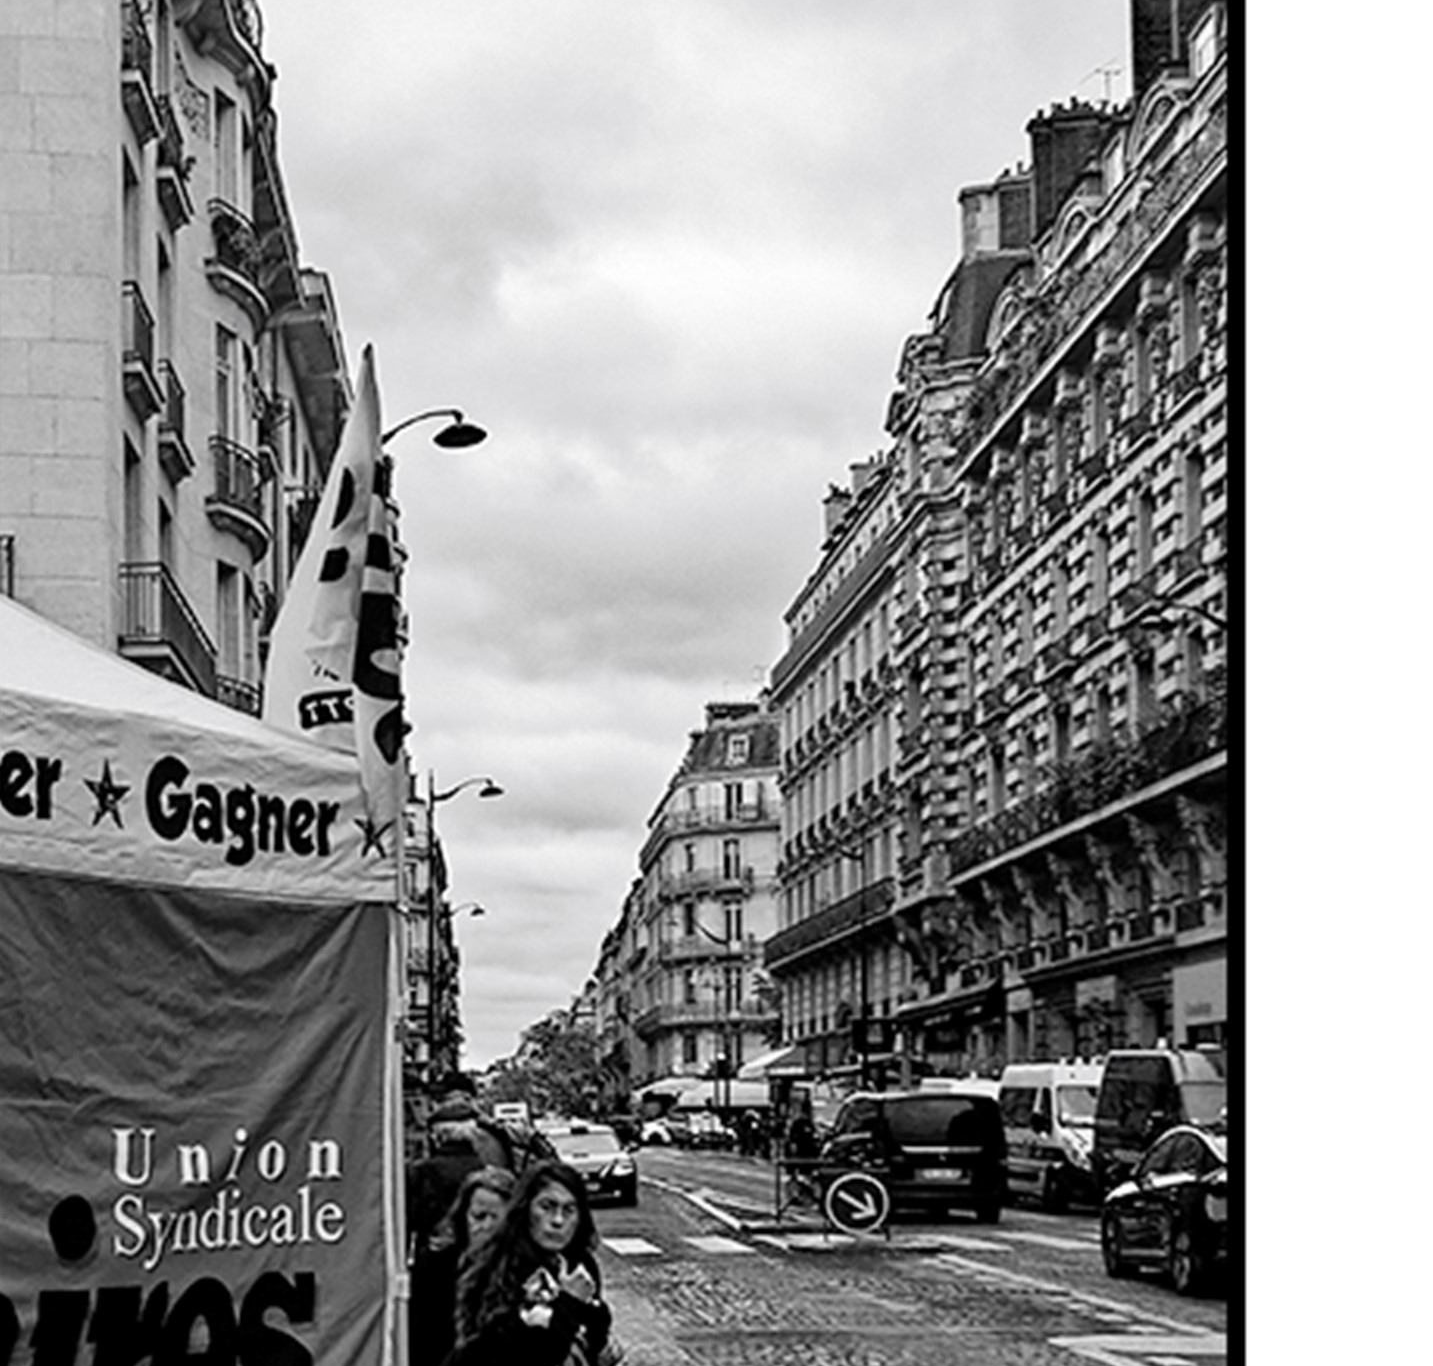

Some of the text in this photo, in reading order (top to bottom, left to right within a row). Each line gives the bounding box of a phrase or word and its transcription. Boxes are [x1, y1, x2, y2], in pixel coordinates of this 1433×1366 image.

[144, 755, 341, 866] Gagner
[111, 1127, 343, 1185] Union
[113, 1186, 345, 1271] Syndicale
